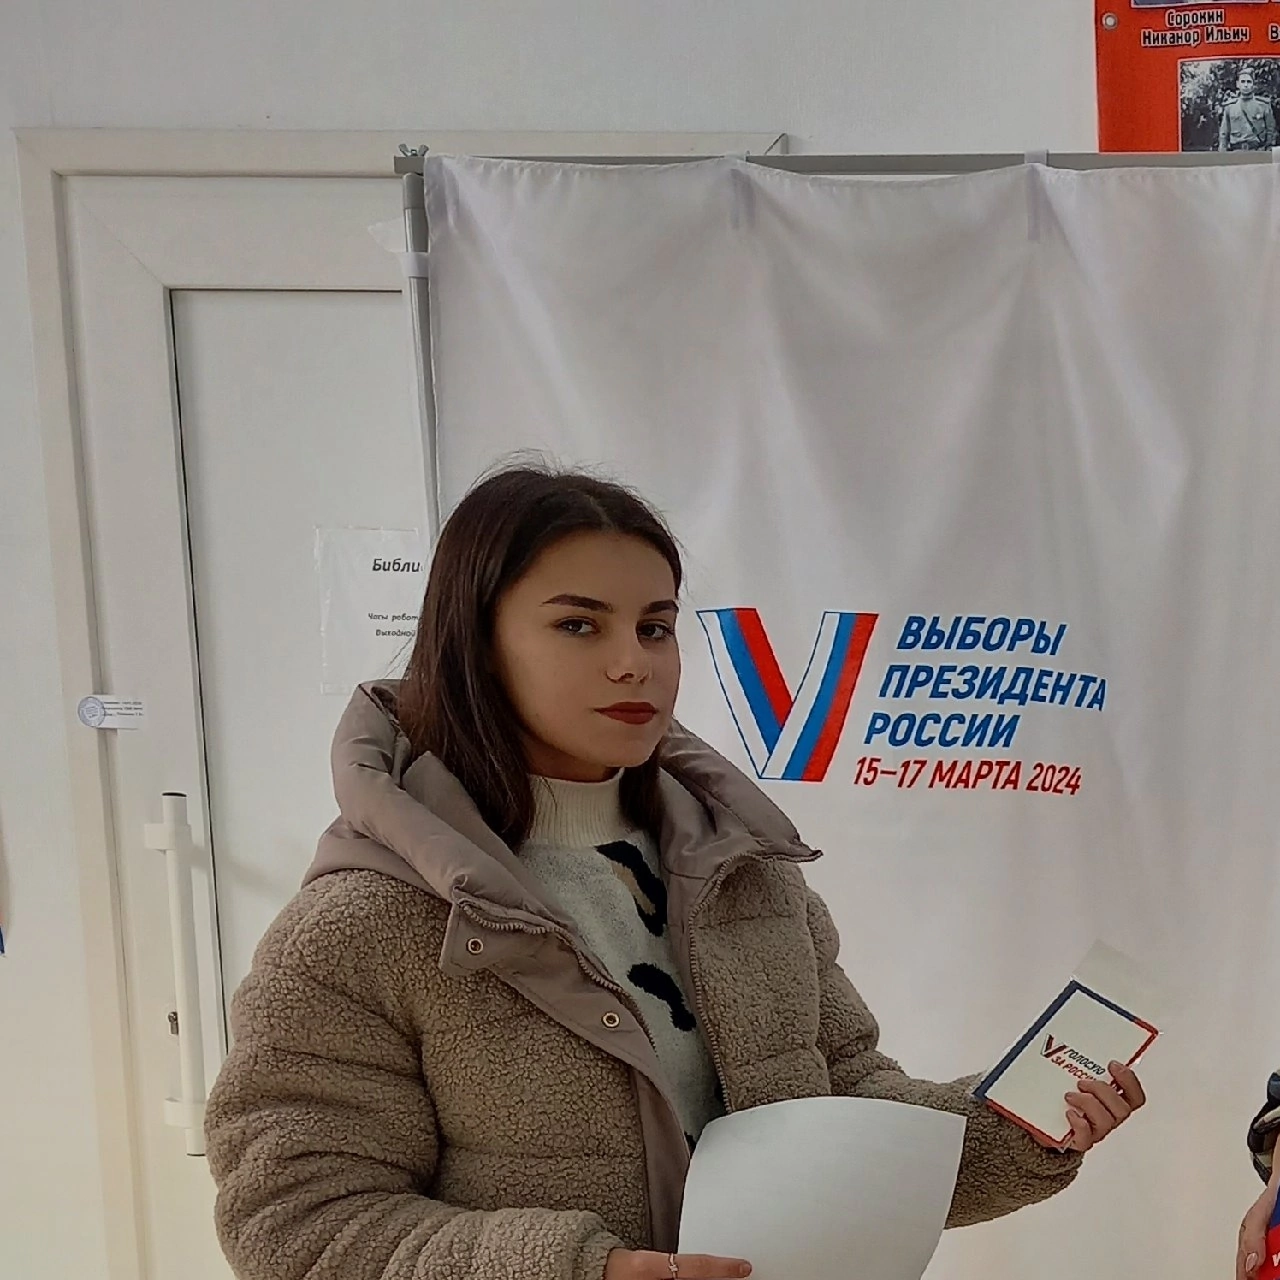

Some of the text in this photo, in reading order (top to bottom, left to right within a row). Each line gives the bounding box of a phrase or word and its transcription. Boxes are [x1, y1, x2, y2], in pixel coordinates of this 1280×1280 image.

[1166, 9, 1224, 27] Сорокин
[1142, 26, 1248, 47] Никанор Ильич
[372, 558, 422, 573] Библи
[391, 612, 419, 622] работ
[896, 614, 1067, 655] ВЫБОРЫ
[878, 664, 1108, 711] ПРЕЗИДЕНТА
[863, 712, 1021, 749] РОССИИ
[929, 759, 1021, 790] МАРТА
[1025, 762, 1082, 796] 2024
